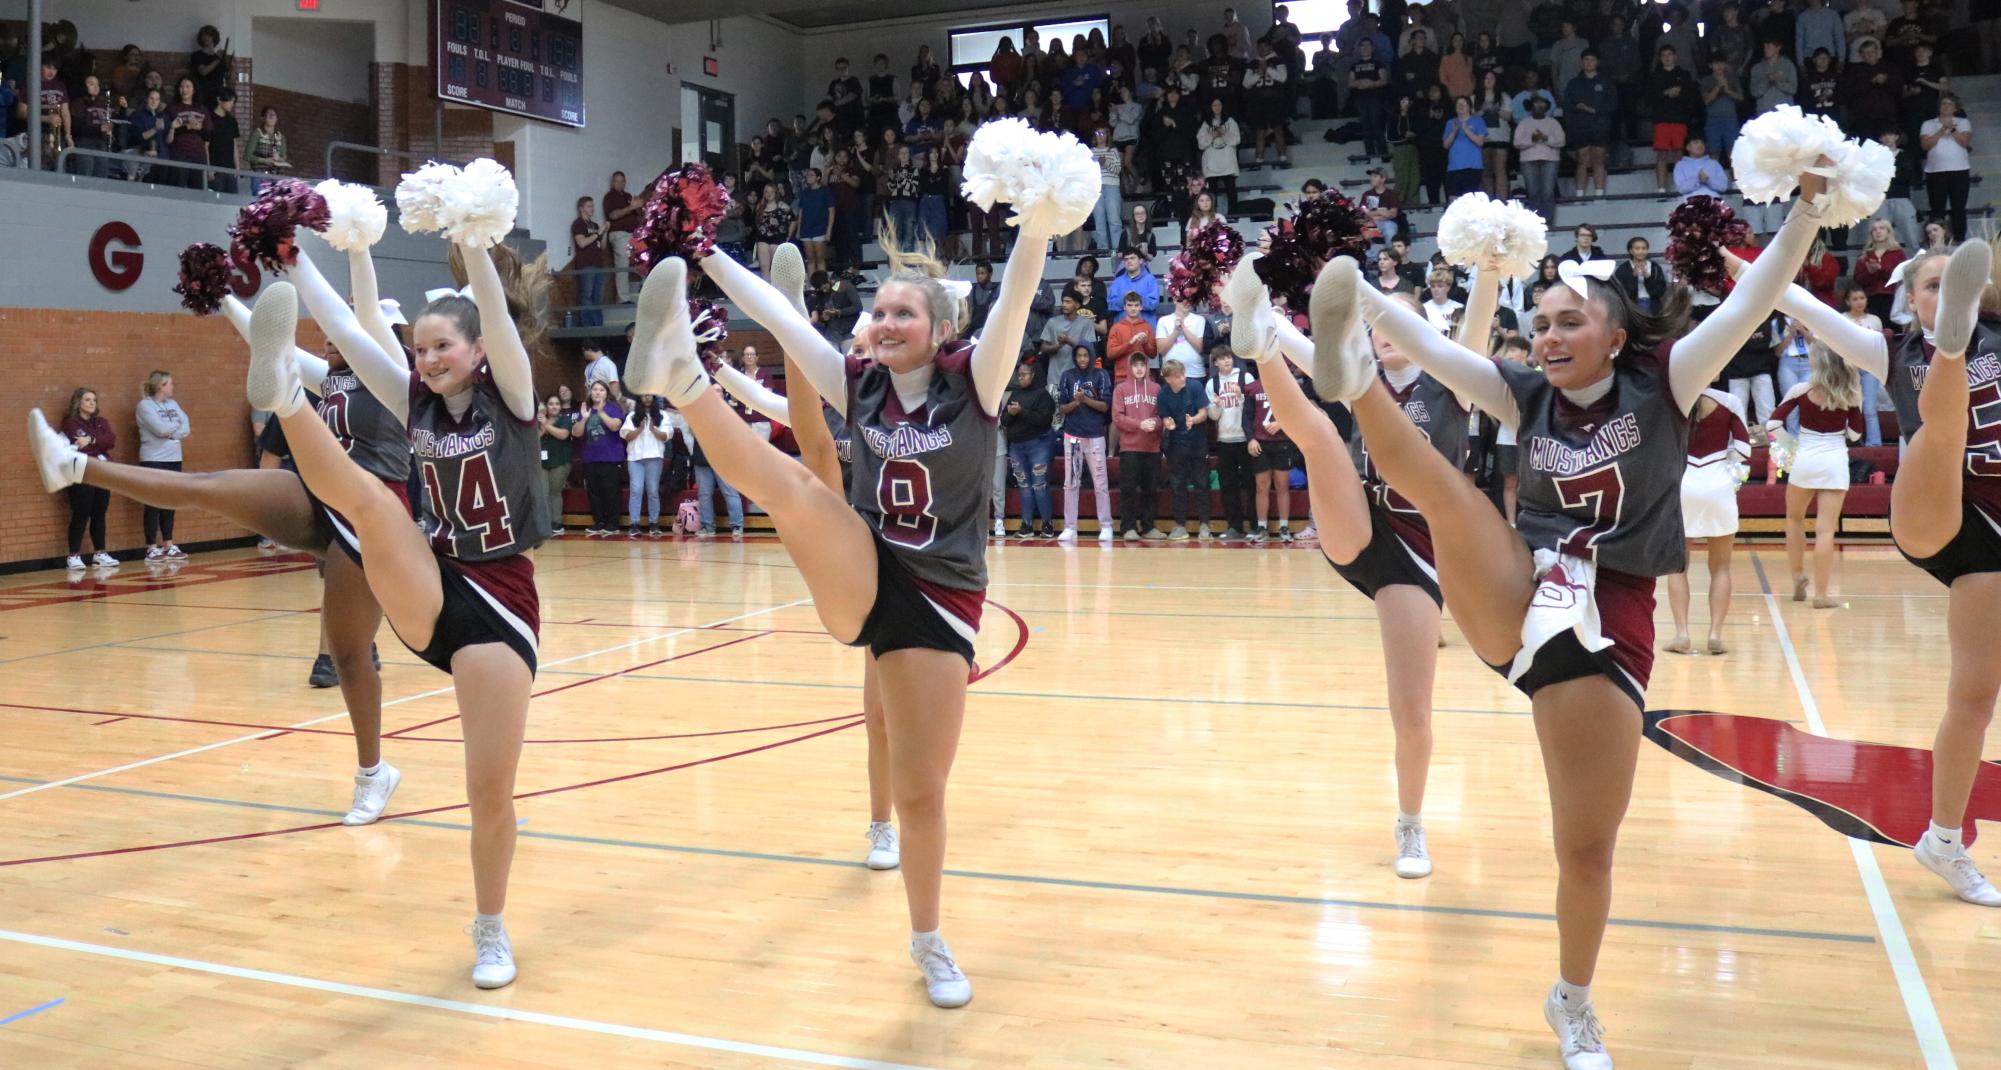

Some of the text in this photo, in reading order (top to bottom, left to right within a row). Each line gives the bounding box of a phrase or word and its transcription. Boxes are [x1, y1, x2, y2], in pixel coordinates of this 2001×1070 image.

[504, 11, 526, 26] PERIOD
[447, 41, 468, 56] FOULS
[497, 54, 519, 69] PLAYER
[520, 58, 535, 73] FOUL
[560, 70, 578, 83] FOULS
[447, 84, 468, 98] SCORE
[505, 97, 526, 111] MATCH
[561, 109, 579, 122] SCORE
[411, 420, 496, 459] MUSTANGS
[857, 423, 953, 460] USTANGS
[1529, 412, 1641, 475] MUSTANGS
[422, 450, 516, 558] 14
[876, 459, 939, 550] 8
[1552, 461, 1626, 562] 7
